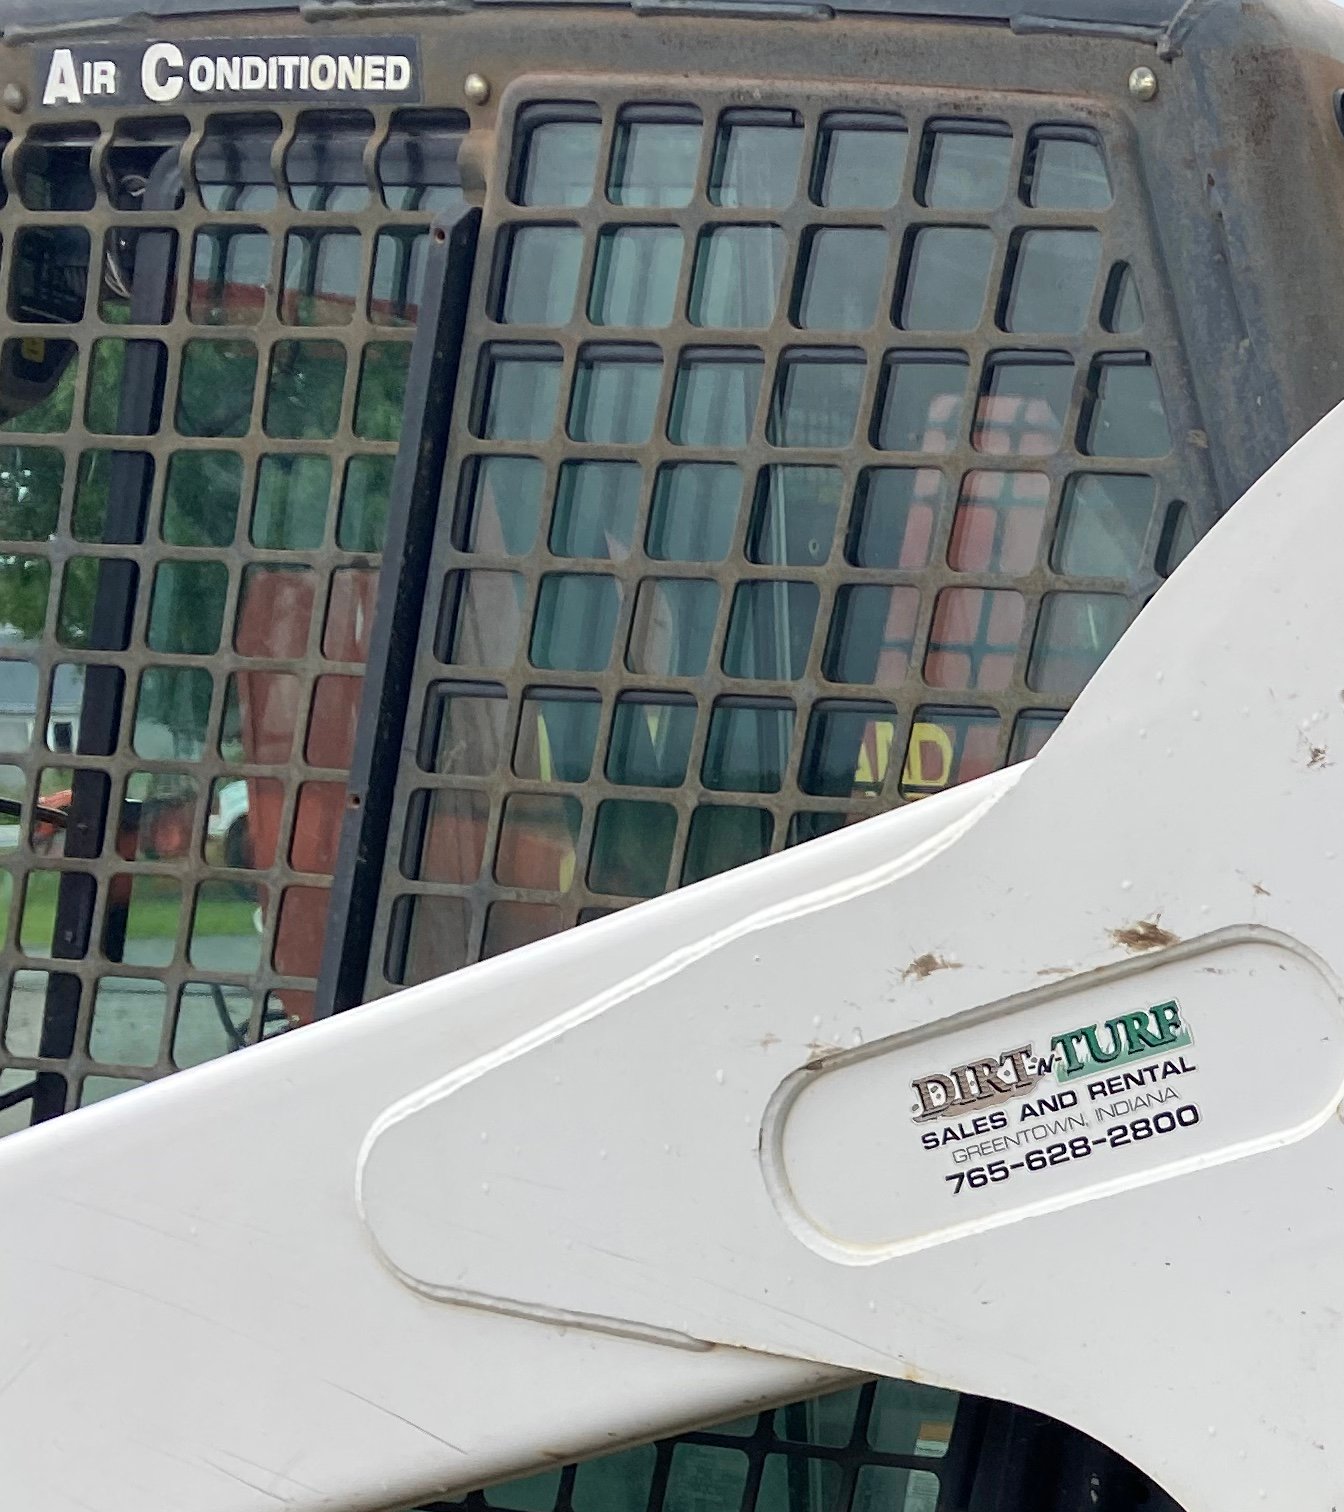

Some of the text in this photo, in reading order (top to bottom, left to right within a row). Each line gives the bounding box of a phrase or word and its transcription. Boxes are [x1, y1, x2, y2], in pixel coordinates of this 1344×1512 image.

[921, 1056, 1196, 1150] SALES AND RENTAL
[952, 1086, 1179, 1164] GREENTOWN, INDIANA
[946, 1104, 1199, 1194] 765-628-2800
